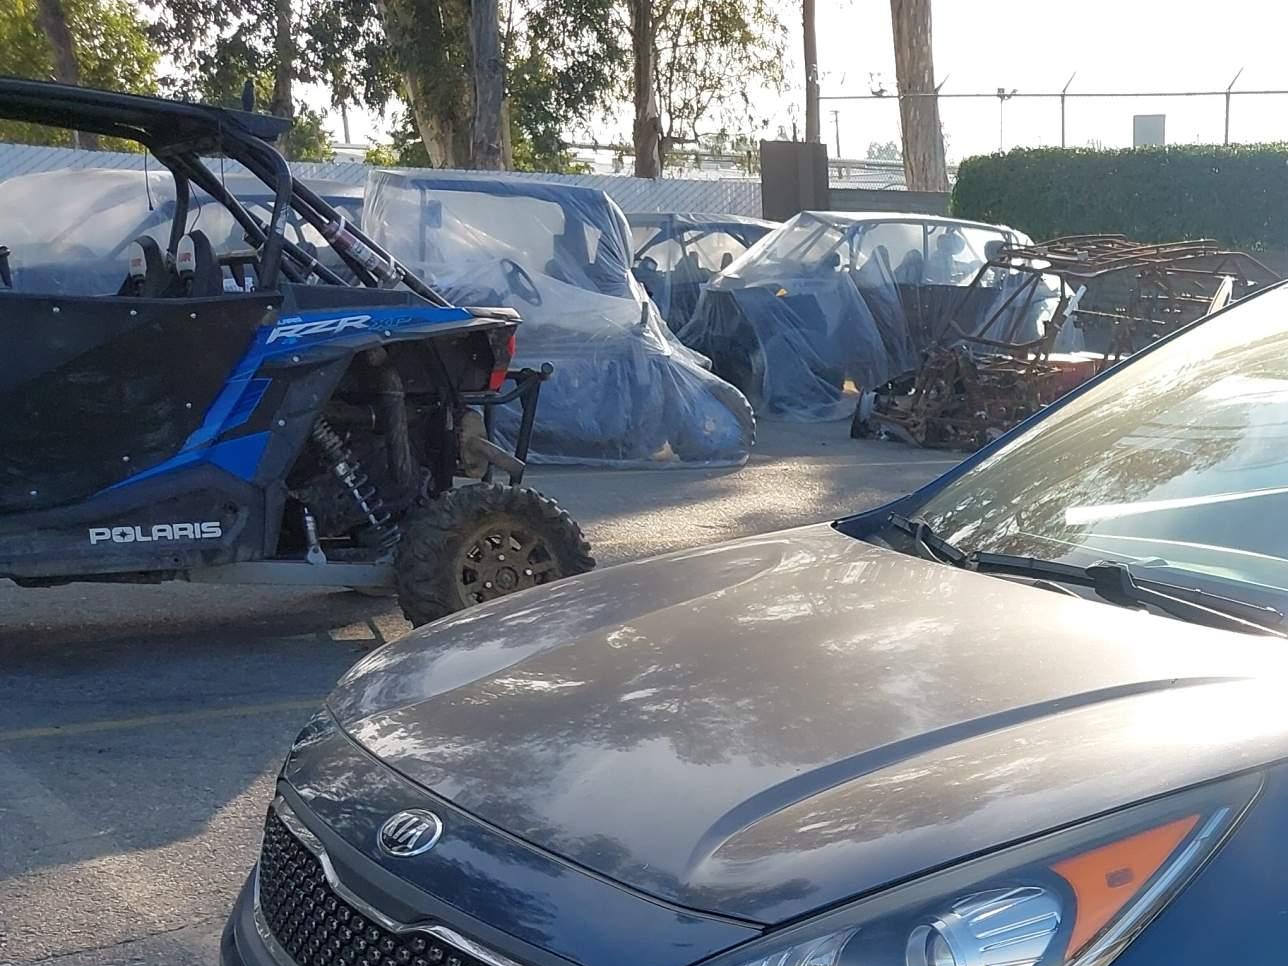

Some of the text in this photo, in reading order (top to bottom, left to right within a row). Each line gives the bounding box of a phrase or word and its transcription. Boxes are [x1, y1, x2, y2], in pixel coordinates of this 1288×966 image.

[266, 315, 372, 345] RZR
[89, 521, 222, 545] POLARIS
[381, 813, 431, 850] KIA
